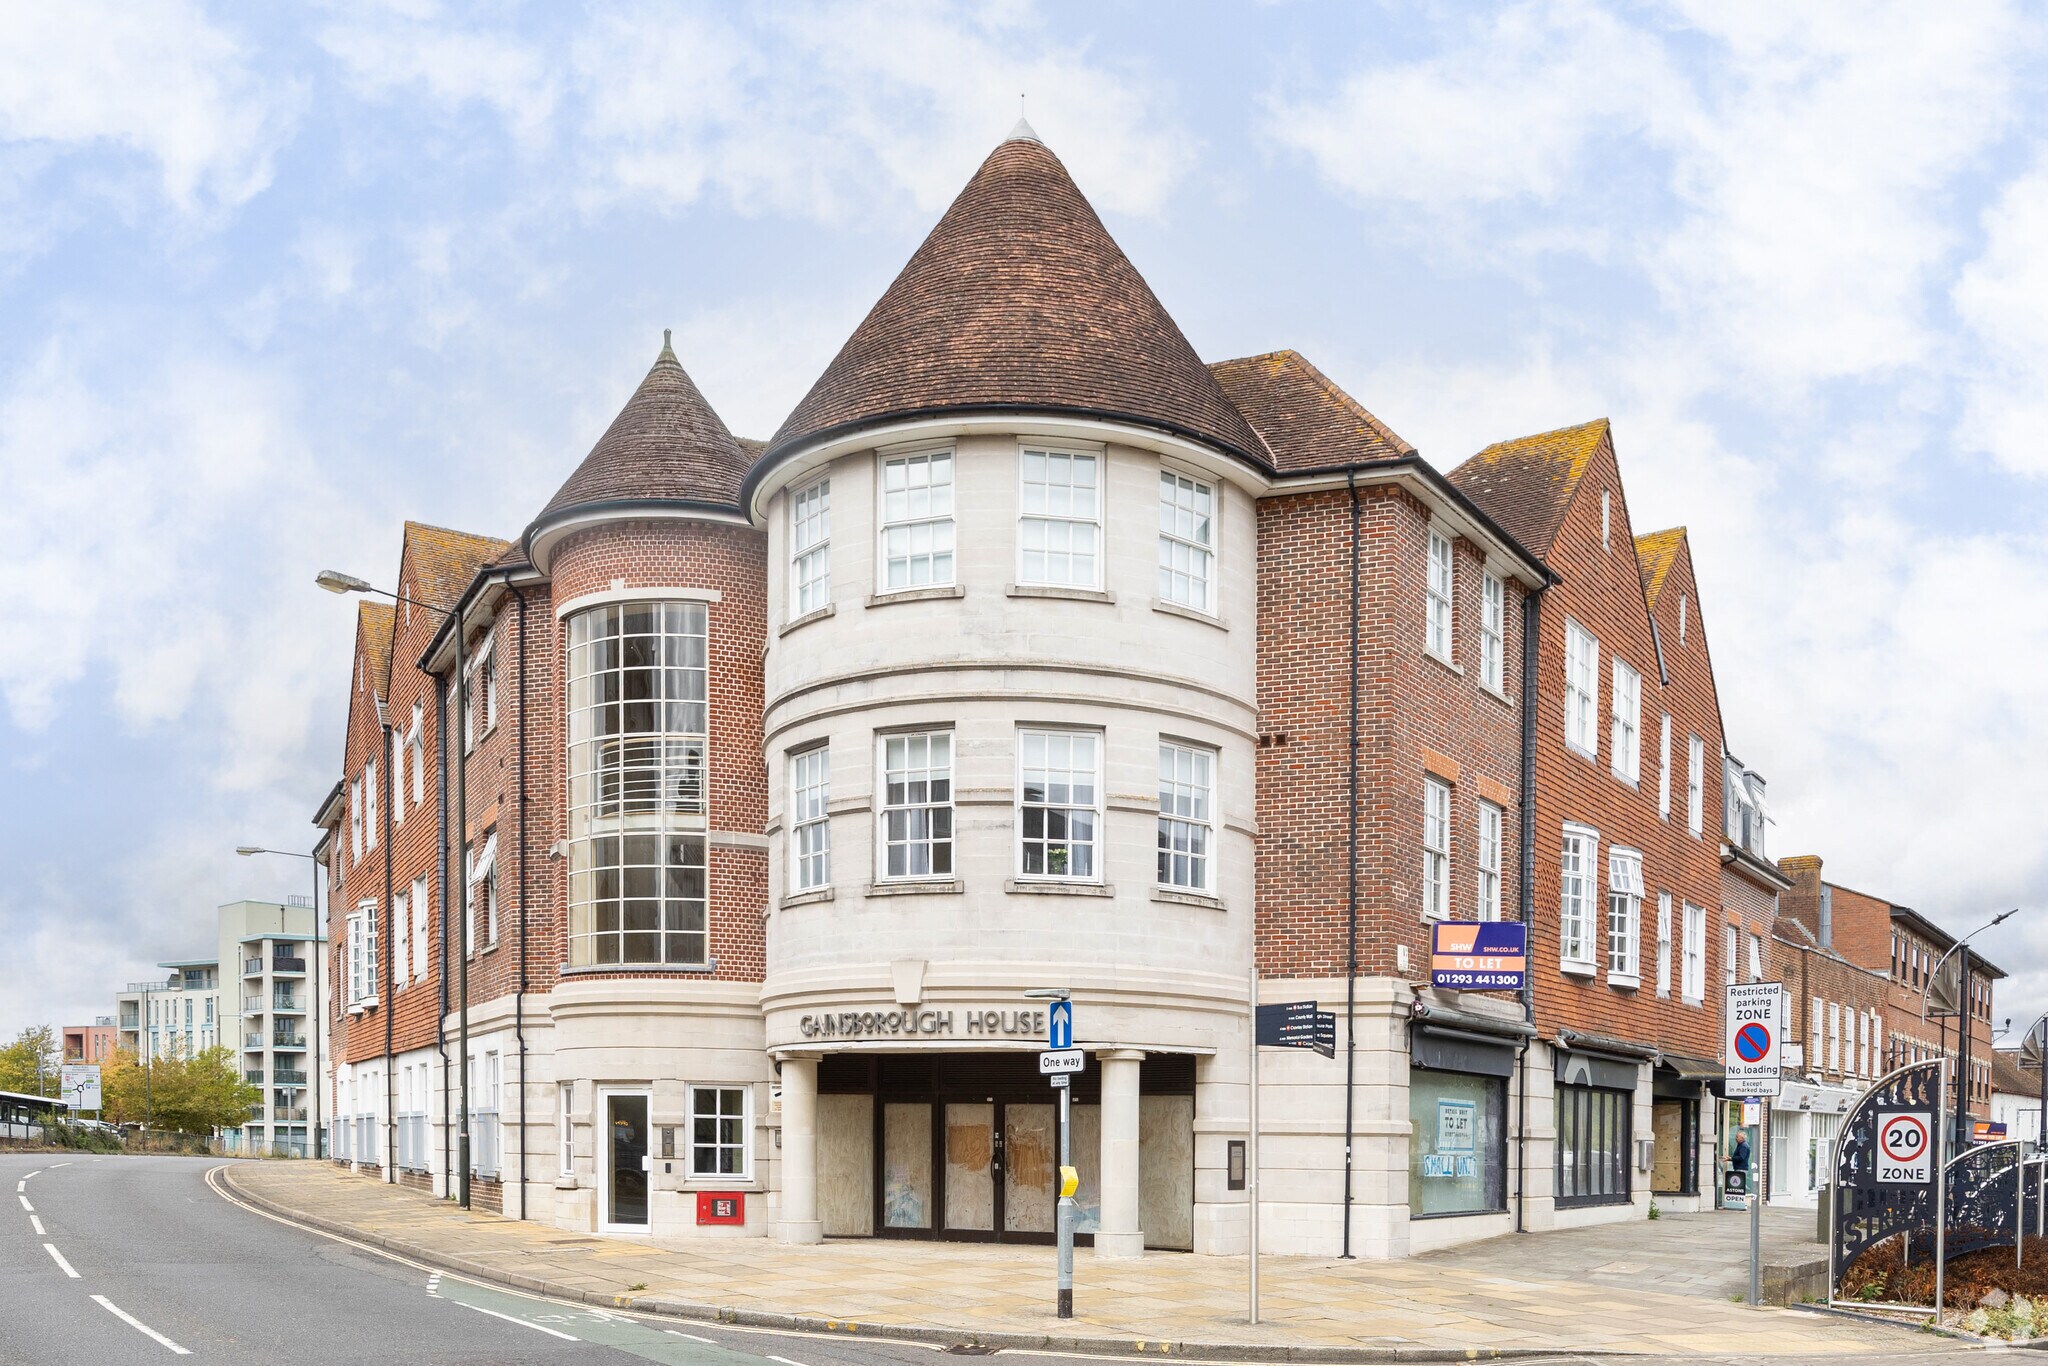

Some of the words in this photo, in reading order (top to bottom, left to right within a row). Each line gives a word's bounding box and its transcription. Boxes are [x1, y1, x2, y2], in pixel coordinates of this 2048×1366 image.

[1451, 943, 1472, 951] SHW
[1454, 957, 1474, 969] TO
[1480, 958, 1503, 969] LET
[1437, 974, 1472, 984] 01293
[1475, 975, 1518, 985] 441300
[1730, 986, 1779, 997] Restricted
[1736, 998, 1772, 1008] parking
[1736, 1009, 1771, 1020] ZONE
[800, 1010, 953, 1036] GAINSBOROUGH
[966, 1010, 1046, 1034] HOUSE
[1043, 1057, 1060, 1067] One
[1063, 1057, 1080, 1067] way
[1728, 1066, 1740, 1074] No
[1744, 1065, 1778, 1075] loading
[1759, 1086, 1773, 1094] bays
[1445, 1117, 1454, 1129] TO
[1456, 1117, 1468, 1130] LET
[1889, 1129, 1921, 1148] 20
[1424, 1155, 1453, 1176] SMALL
[1882, 1168, 1925, 1180] ZONE
